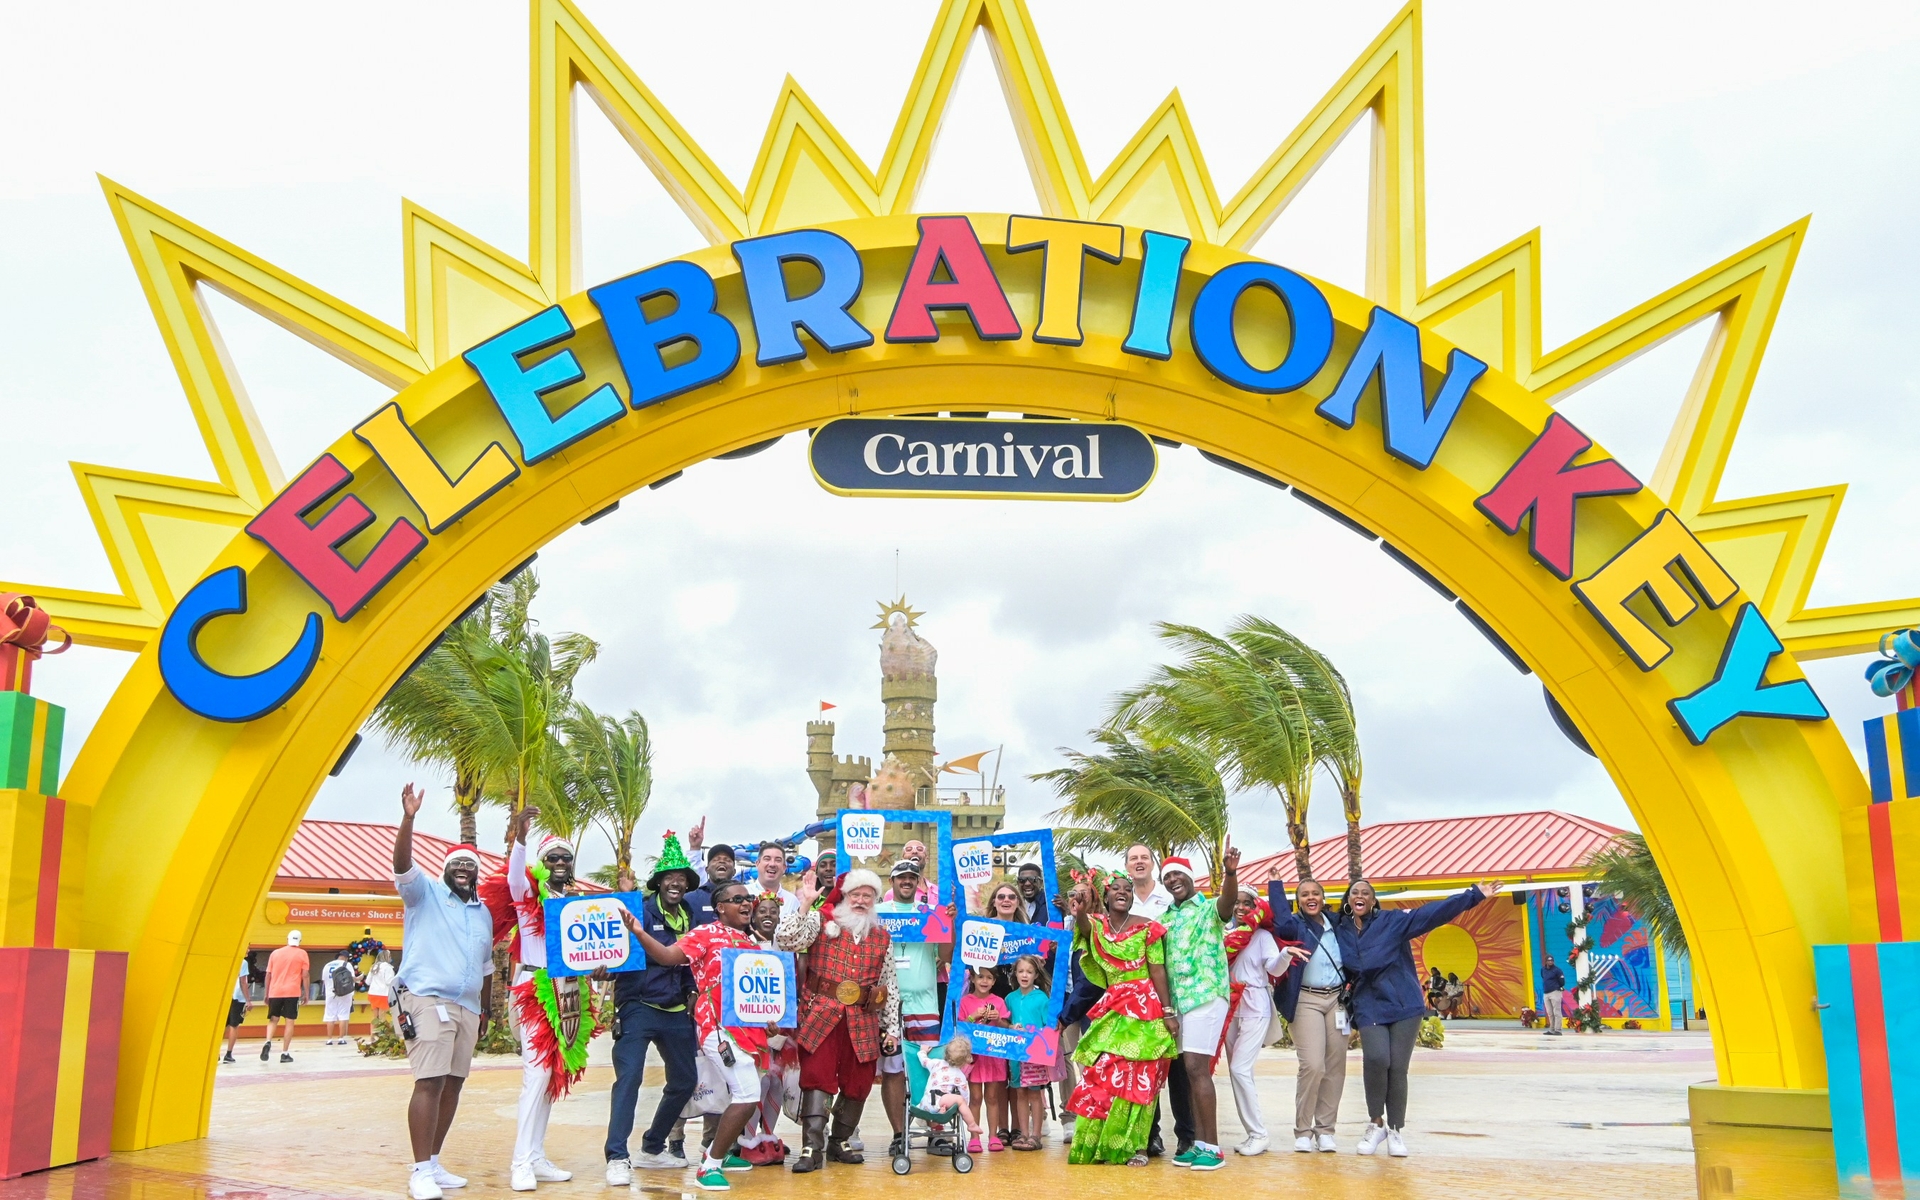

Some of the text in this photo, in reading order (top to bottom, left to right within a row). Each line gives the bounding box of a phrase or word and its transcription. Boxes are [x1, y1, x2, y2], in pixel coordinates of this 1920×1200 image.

[863, 431, 1103, 479] Carnival
[158, 214, 1830, 746] CELEBRATION KEY
[847, 826, 880, 838] ONE
[958, 853, 990, 868] ONE
[960, 870, 991, 880] MILLION
[290, 908, 319, 917] Guest
[320, 909, 361, 918] Services
[367, 910, 394, 919] Shore
[588, 912, 606, 921] AM
[567, 920, 623, 943] ONE
[584, 940, 607, 951] IN A
[965, 934, 999, 950] ONE
[569, 948, 623, 963] MILLION
[963, 951, 997, 962] MILLION
[755, 967, 769, 976] AM
[738, 975, 781, 995] ONE
[751, 995, 769, 1003] IN A
[739, 1003, 781, 1015] MILLION
[972, 1029, 1026, 1045] CELEBRATION
[990, 1039, 1008, 1048] KEY
